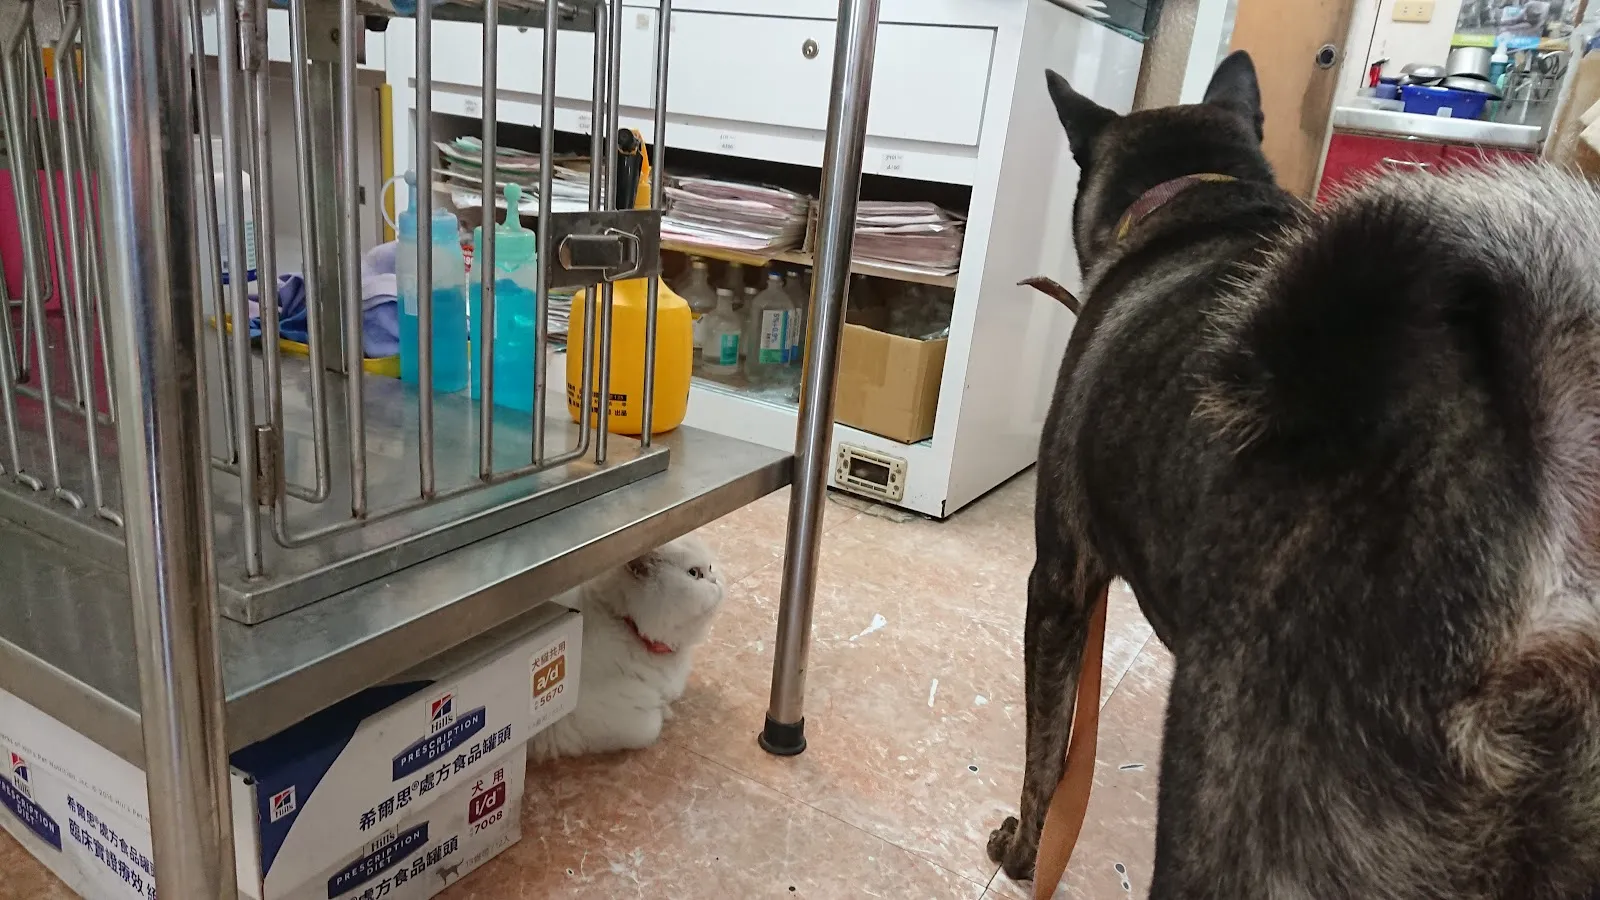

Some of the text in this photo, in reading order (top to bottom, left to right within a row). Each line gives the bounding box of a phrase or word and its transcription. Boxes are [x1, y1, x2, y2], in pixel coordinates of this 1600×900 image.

[540, 684, 564, 707] 5670
[431, 713, 454, 734] Hill's
[400, 715, 480, 767] PRESCRIPTION
[428, 739, 454, 760] DIET
[17, 805, 35, 826] DIET
[474, 810, 503, 835] 7008
[371, 831, 396, 852] Hill's
[336, 830, 421, 886] PRESCRIPTION
[366, 855, 393, 877] DIET
